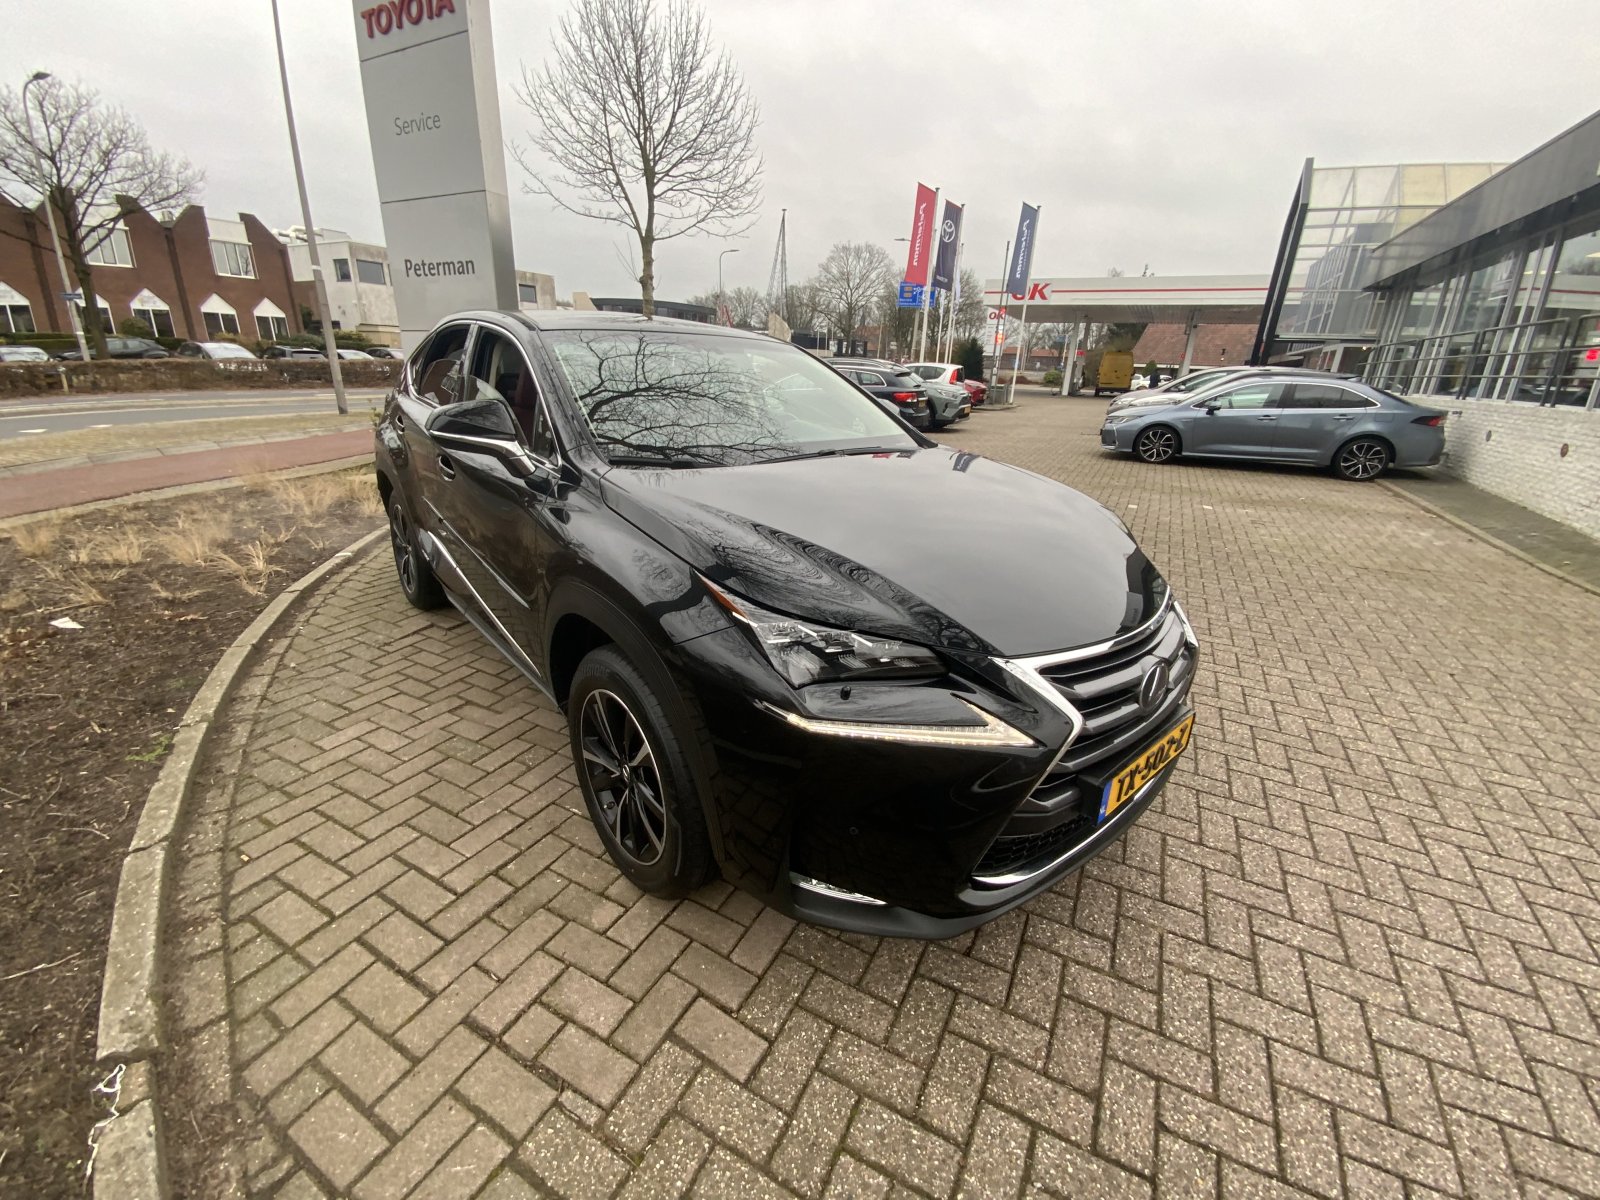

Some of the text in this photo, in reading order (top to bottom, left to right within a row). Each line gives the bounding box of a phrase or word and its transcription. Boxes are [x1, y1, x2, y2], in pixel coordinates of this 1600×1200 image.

[394, 112, 441, 136] Service
[404, 258, 476, 278] Peterman
[1012, 283, 1051, 301] K
